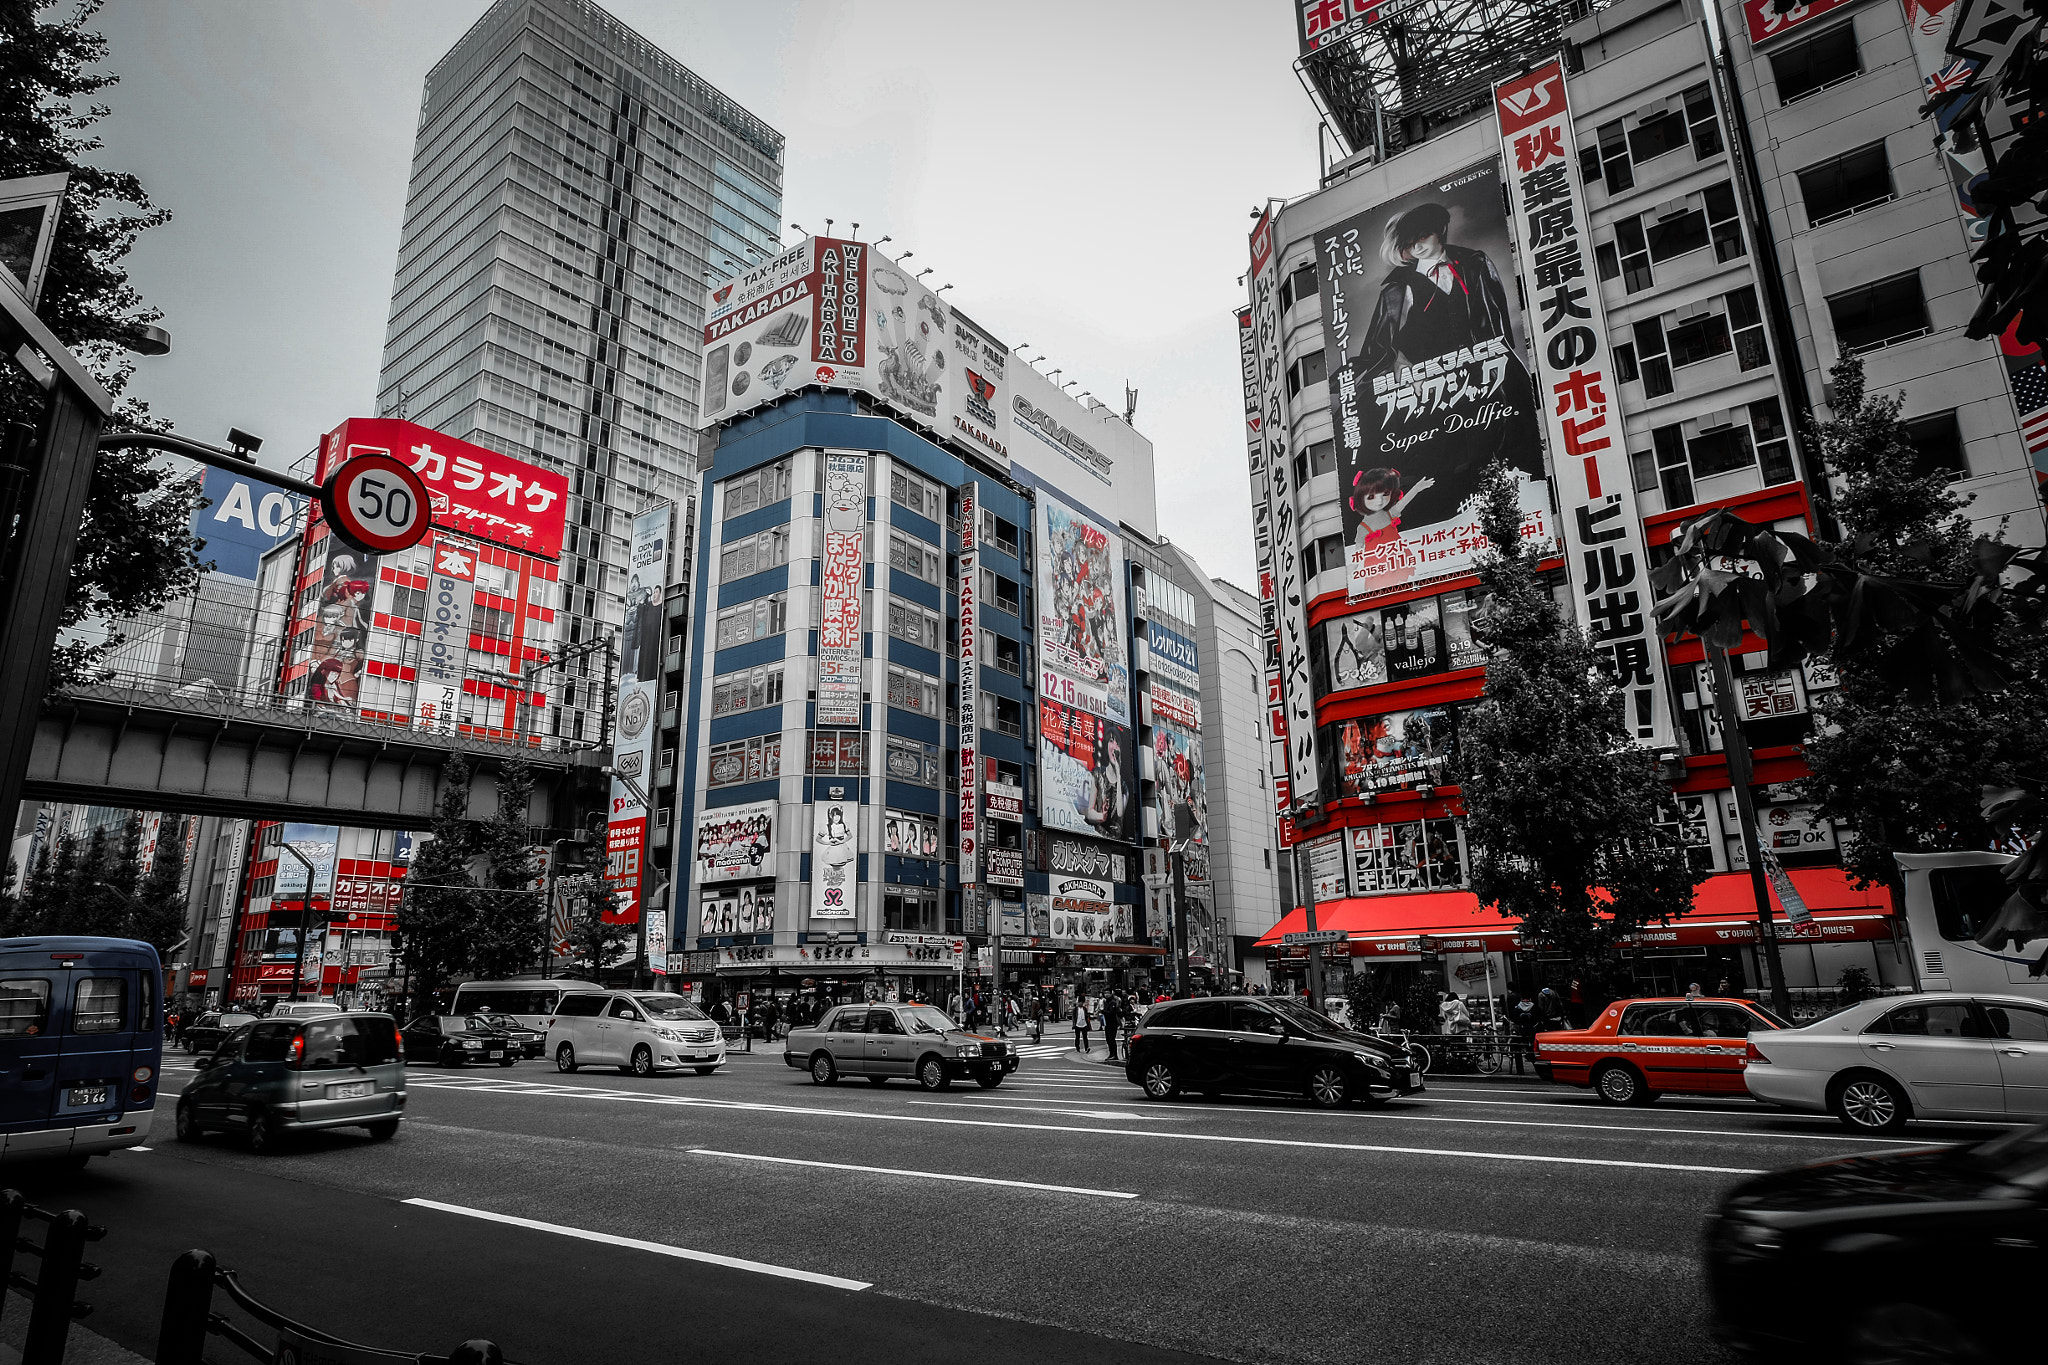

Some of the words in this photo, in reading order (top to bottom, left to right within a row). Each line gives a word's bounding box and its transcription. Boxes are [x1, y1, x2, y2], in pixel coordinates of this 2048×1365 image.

[1308, 18, 1363, 51] VOLKS
[1366, 0, 1400, 25] AKI
[1342, 228, 1364, 276] ついに、
[743, 247, 805, 287] TAX-FREE
[841, 244, 863, 333] WELCOME
[709, 281, 809, 339] TAKARADA
[818, 248, 841, 362] AKIHABARA
[841, 335, 858, 363] TO
[955, 323, 980, 348] DUTY
[982, 343, 1005, 368] FREE
[953, 415, 1008, 458] TAKARADA
[1012, 394, 1114, 475] GAMERS
[1380, 427, 1439, 453] Super
[328, 432, 340, 471] カラ
[409, 443, 557, 513] カラオケ
[828, 463, 864, 473] 秋葉原店
[214, 481, 294, 537] AO
[358, 476, 411, 528] 50
[452, 503, 533, 538] アドアーズ
[961, 496, 973, 550] まんが喫茶
[637, 541, 653, 552] OCN
[438, 551, 472, 576] 本
[636, 558, 652, 569] ONE
[822, 532, 845, 648] まんが喫茶
[844, 532, 862, 648] インターネット
[961, 576, 973, 658] TAKARADA
[1151, 629, 1196, 667] レオパレス21
[1450, 640, 1471, 652] 9.19
[1394, 653, 1436, 671] vallejo
[1042, 671, 1075, 704] 12.15
[1077, 692, 1088, 708] ON
[1089, 697, 1107, 716] SALE
[1745, 678, 1792, 698] ホビー
[1749, 692, 1798, 716] 天国
[625, 714, 643, 726] No.1
[961, 703, 974, 745] 免税商店
[1043, 705, 1095, 741] 花澤香菜
[814, 740, 862, 758] 麻雀
[1368, 777, 1388, 790] 9.19
[1046, 806, 1072, 828] 11.04
[1354, 828, 1390, 849] 4F
[1803, 831, 1826, 843] OK
[606, 849, 640, 876] 即日
[336, 880, 401, 896] カラオケ
[1063, 881, 1104, 897] AKIHABARA
[335, 900, 348, 908] 3F
[350, 901, 367, 909] 受付
[1052, 897, 1114, 915] GAMERS
[1443, 940, 1465, 949] HOBBY
[1640, 933, 1677, 942] PARADISE
[1001, 952, 1033, 964] AKARADA
[85, 1017, 121, 1025] FUSO
